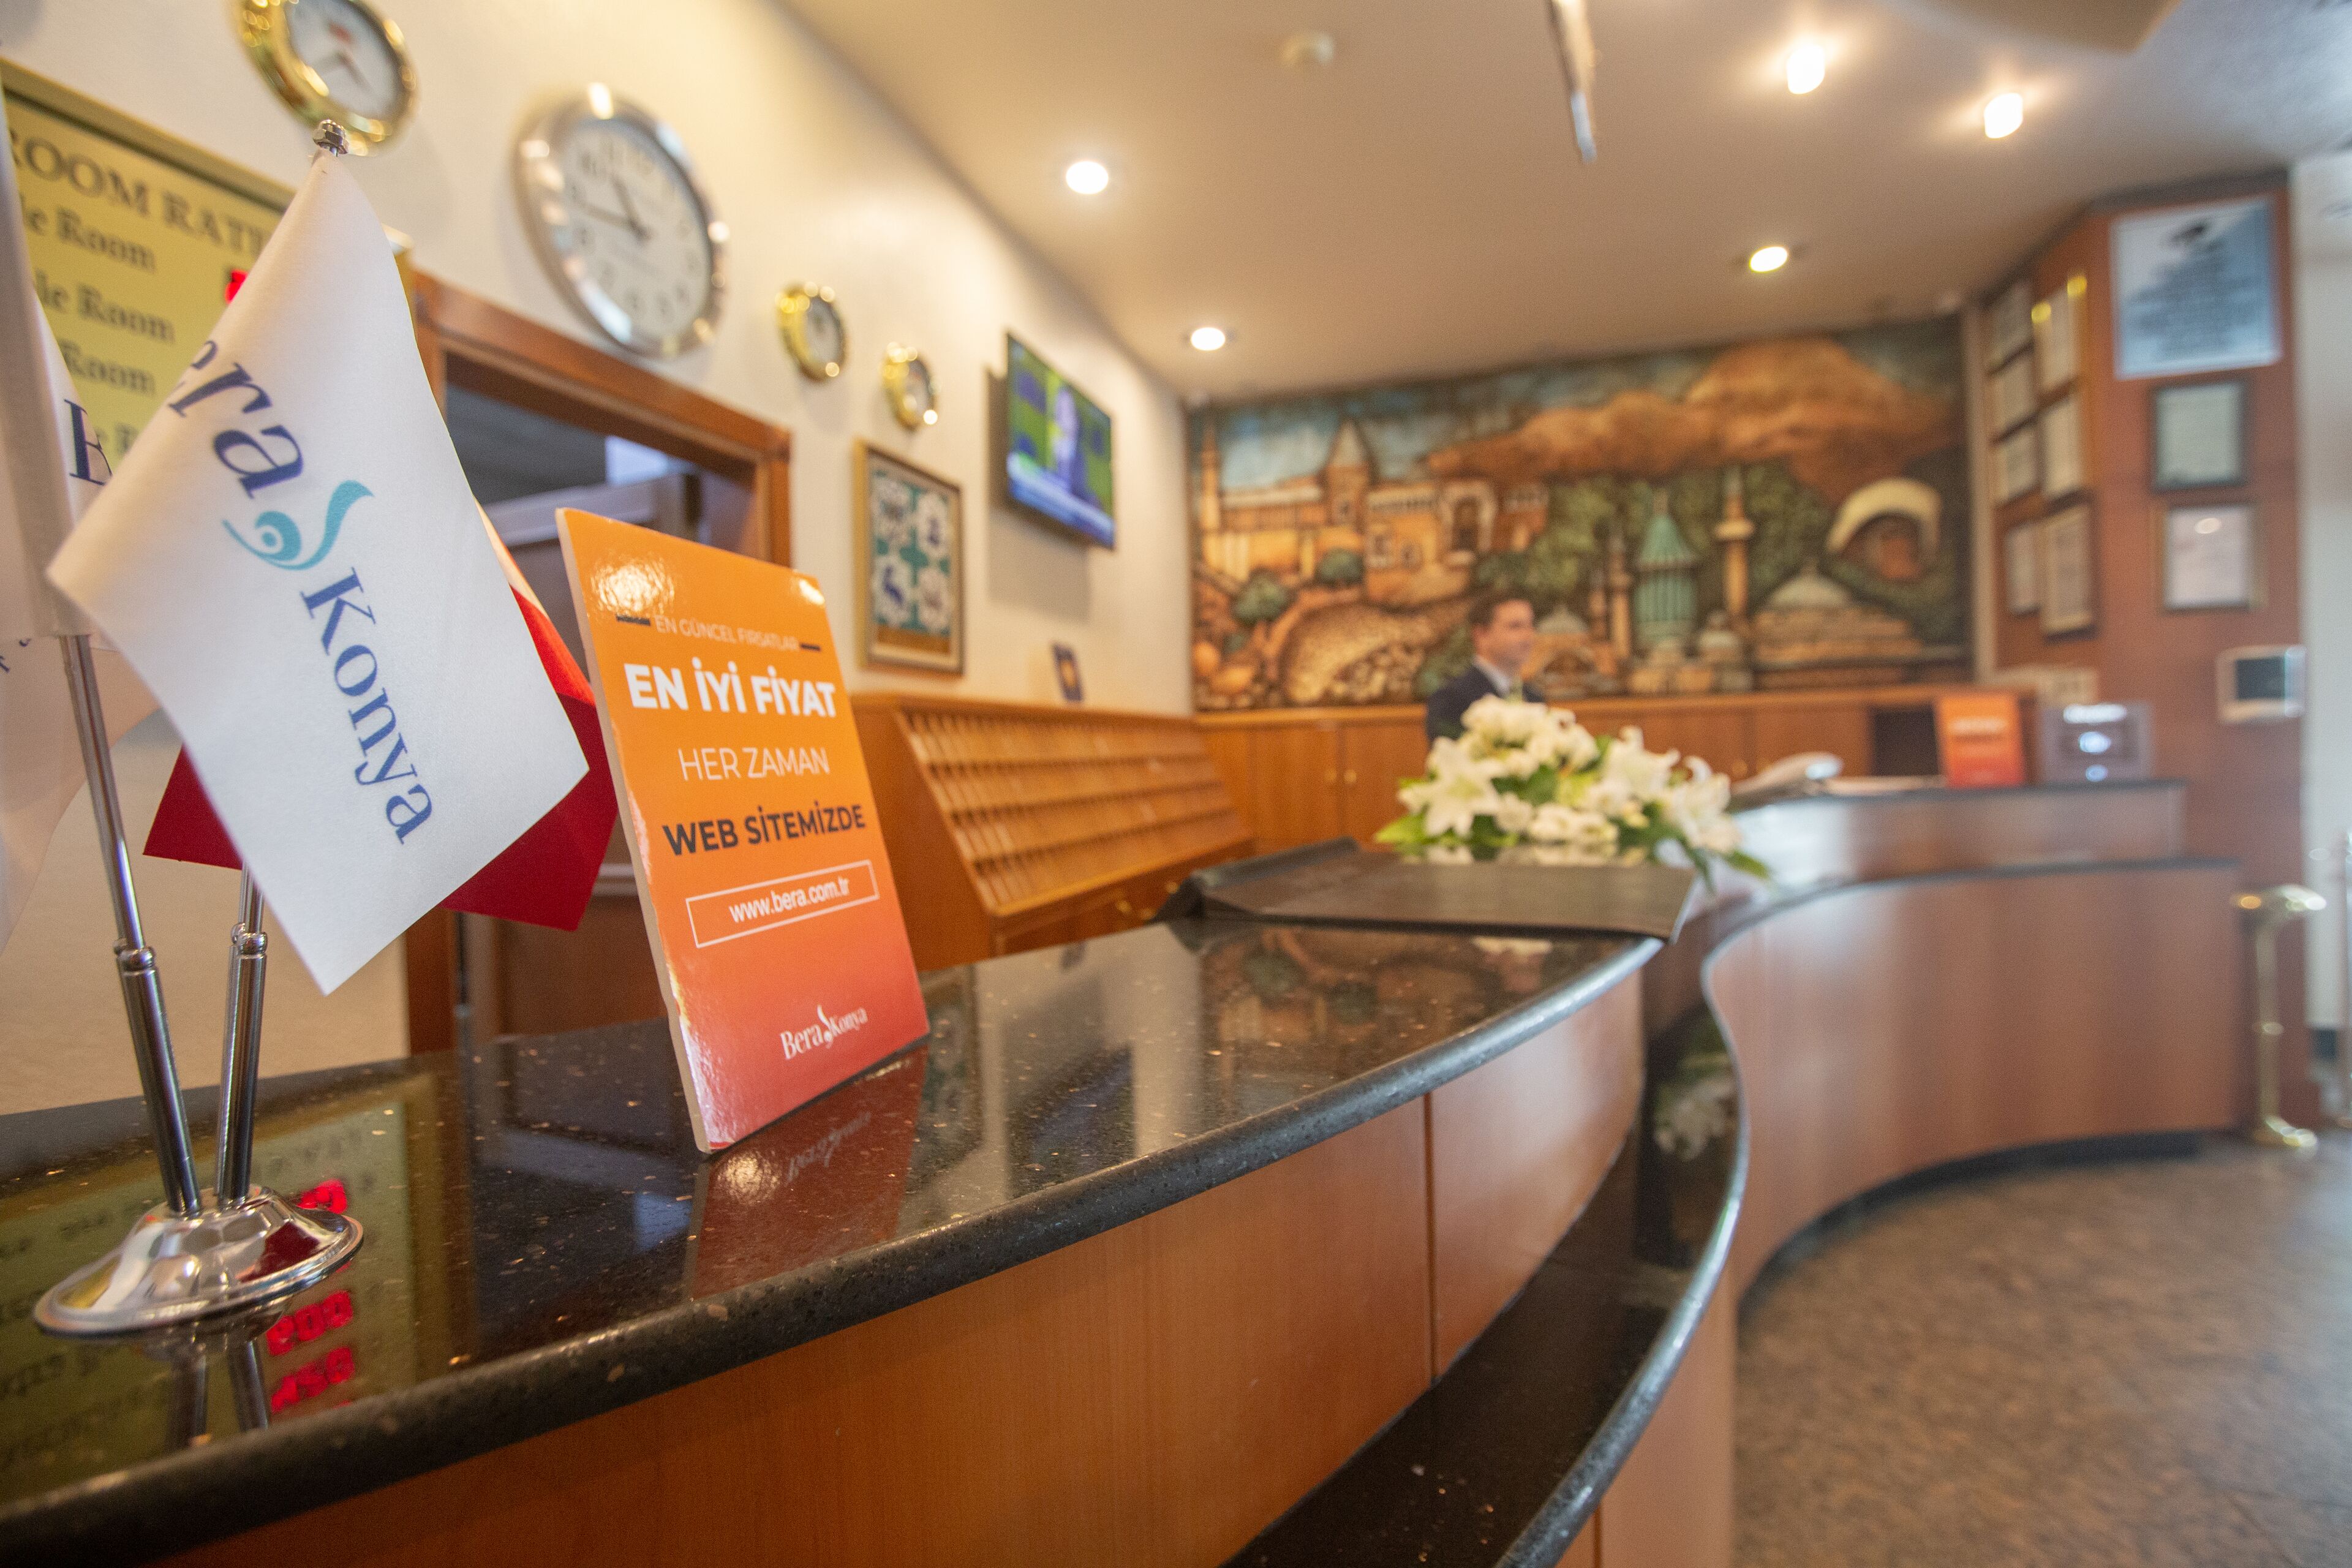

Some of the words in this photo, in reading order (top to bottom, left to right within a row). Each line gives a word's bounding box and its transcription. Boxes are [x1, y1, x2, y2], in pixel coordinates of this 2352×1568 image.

[56, 206, 158, 274] Room
[76, 282, 176, 344] Room
[655, 614, 677, 635] EN
[679, 616, 735, 644] GÜNCEL
[300, 567, 434, 845] Konya
[624, 663, 688, 710] EN
[692, 657, 747, 714] İYİ
[750, 665, 837, 718] FİYAT
[678, 747, 741, 782] HER
[742, 747, 831, 780] ZAMAN
[662, 818, 739, 856] WEB
[744, 800, 865, 845] SİTEMİZDE
[728, 876, 850, 923] www.bera.com.tr
[780, 1023, 824, 1060] Bera
[828, 1006, 869, 1038] Konya
